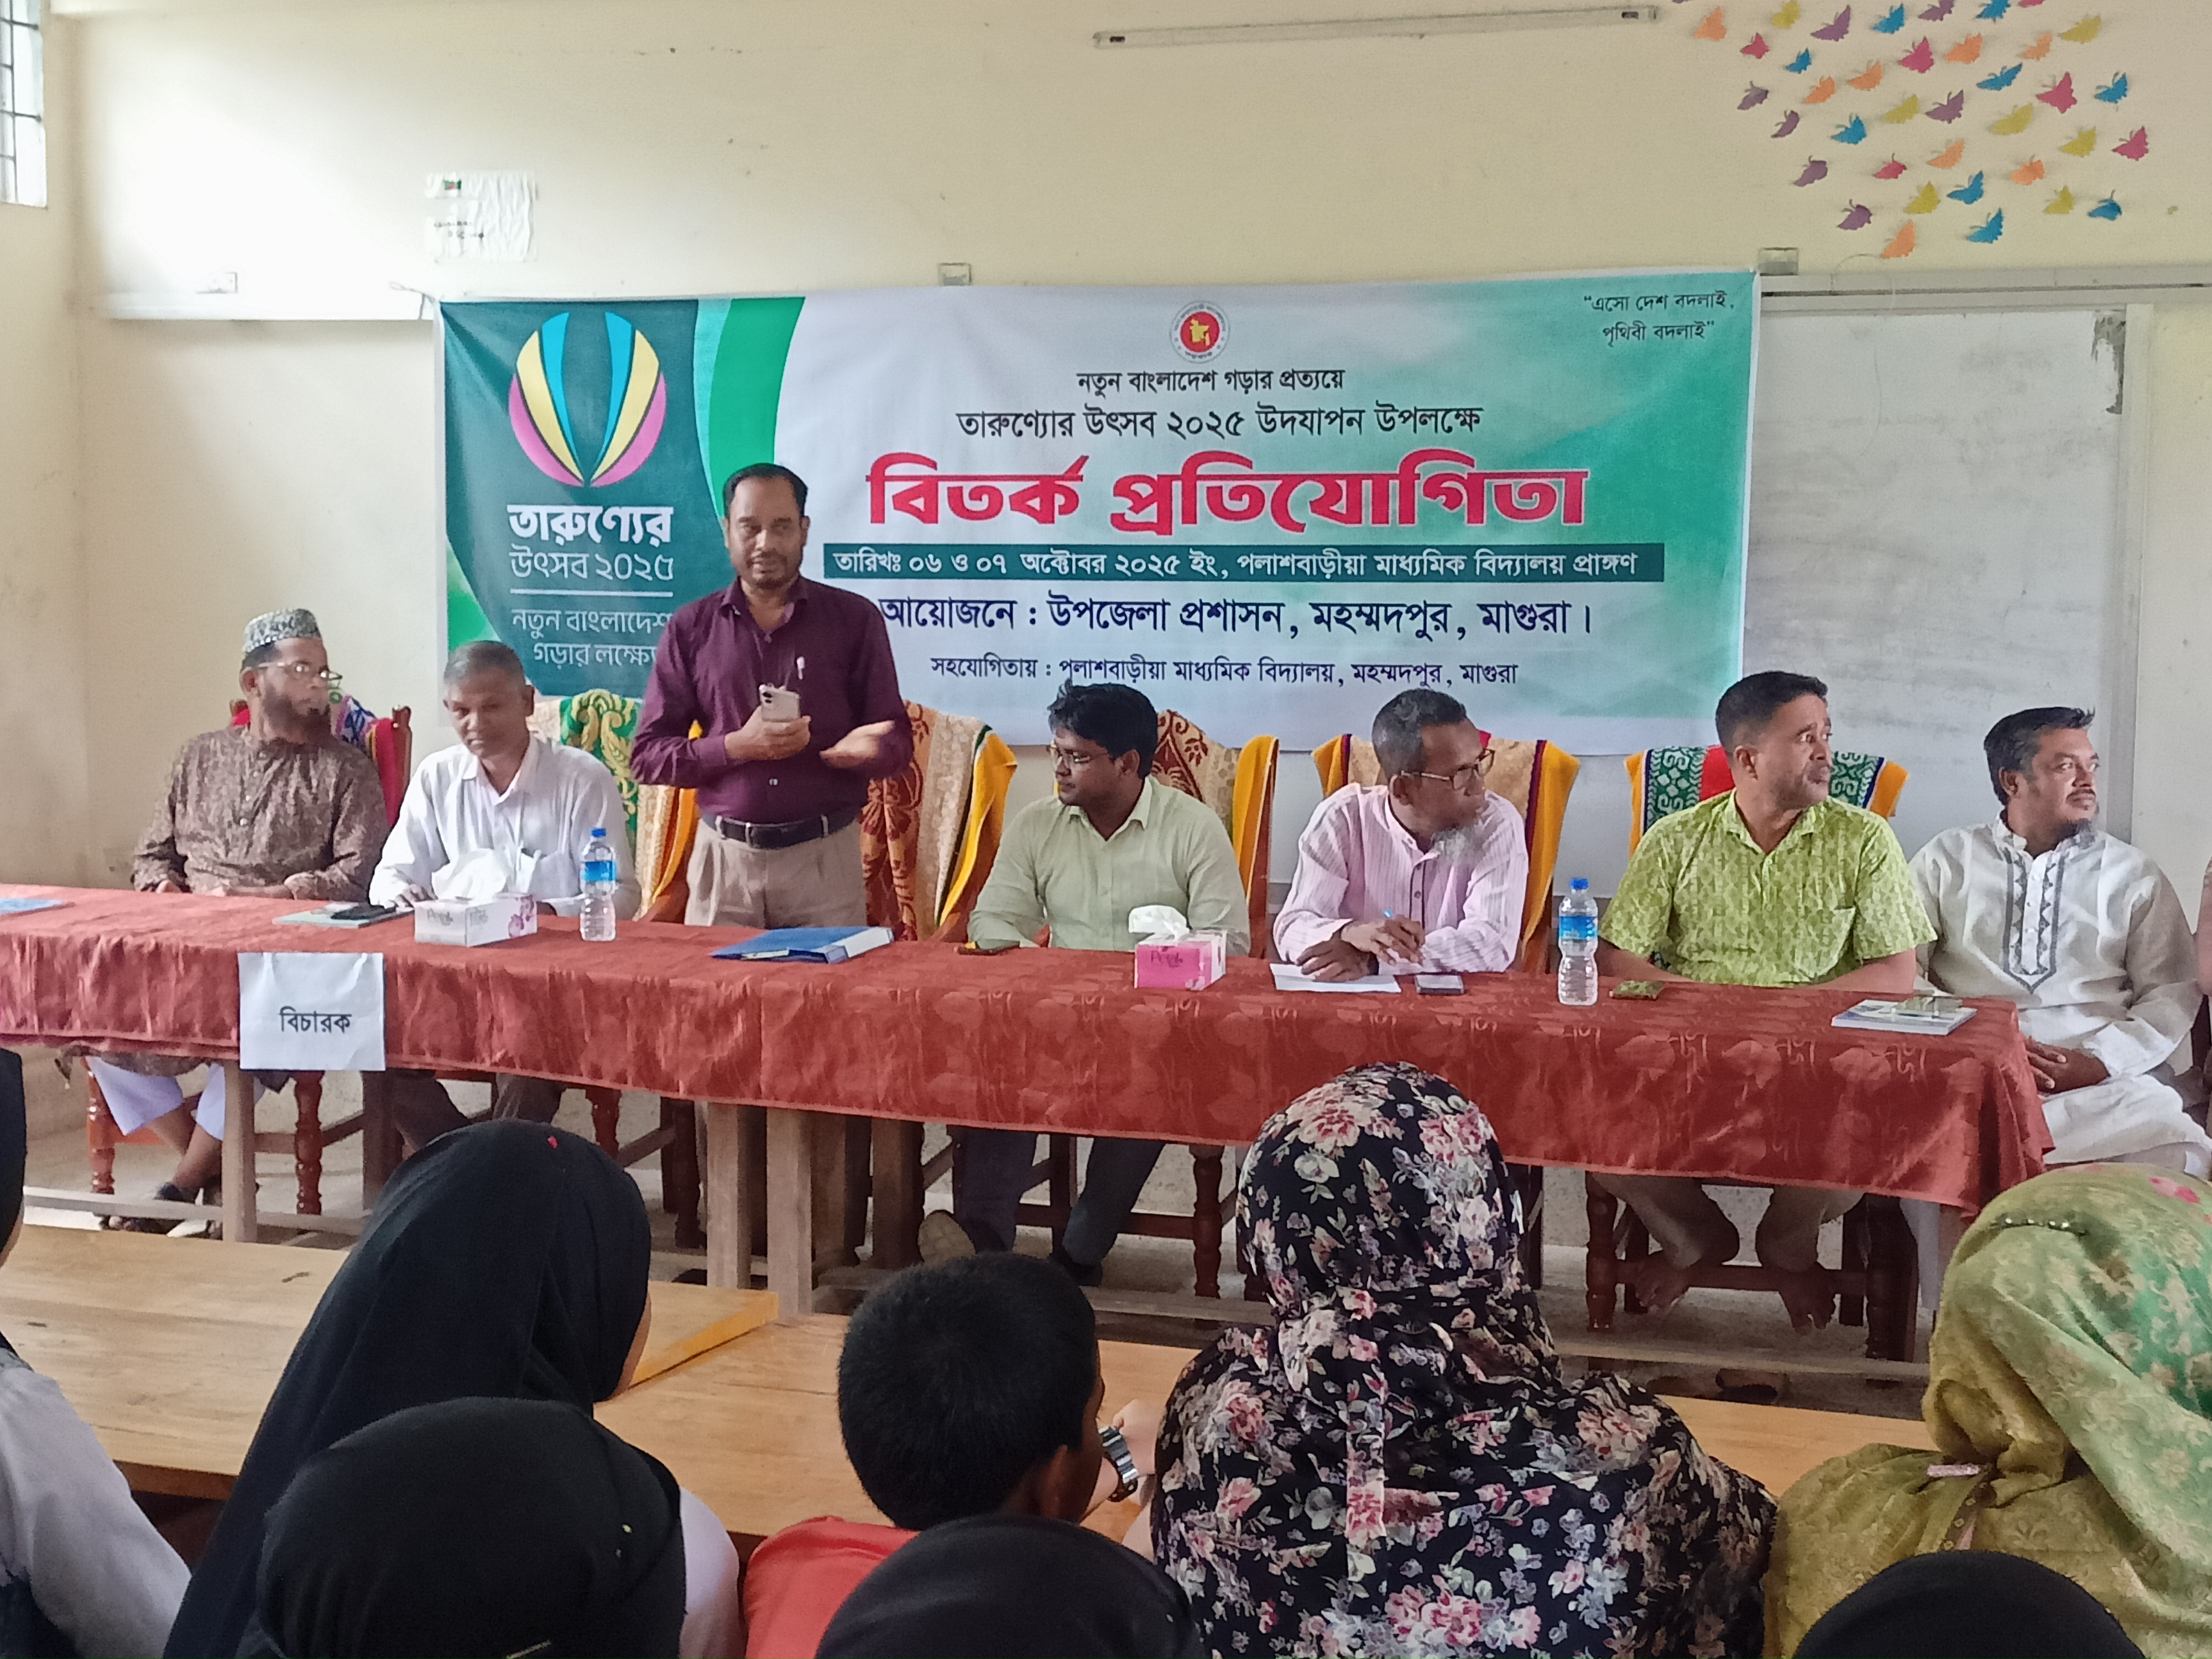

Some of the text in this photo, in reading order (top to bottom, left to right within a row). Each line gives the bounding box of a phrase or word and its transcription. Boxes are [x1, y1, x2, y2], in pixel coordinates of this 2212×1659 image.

[1636, 295, 1668, 311] দেশ
[1603, 320, 1646, 347] পৃথিবী
[1076, 368, 1345, 398] নতুন বাংলাদেশ গড়ার প্রত্যয়ে
[1082, 403, 1157, 437] উৎসব
[1167, 411, 1244, 440] ২০২৫
[1255, 401, 1365, 436] উদযাপন
[1374, 399, 1484, 435] উপলক্ষে
[865, 449, 1590, 535] বিতর্ক প্রতিযোগিতা
[507, 504, 674, 547] তারুণ্যের
[508, 544, 674, 581] উৎসব ২০২৫
[909, 554, 942, 573] ০৬
[951, 555, 969, 572] ও
[976, 554, 1007, 574] ০৭
[1020, 548, 1108, 575] অক্টোবর
[1115, 555, 1181, 577] ২০২৫
[1237, 548, 1368, 579] পলাশবাড়ীয়া
[1374, 549, 1468, 576] মাধ্যমিক
[1473, 548, 1567, 577] বিদ্যালয়
[1572, 552, 1639, 576] প্রাঙ্গণ
[511, 609, 562, 639] নতুন
[878, 596, 1018, 630] আয়োজনে
[1046, 589, 1171, 632] উপজেলা
[533, 643, 591, 669] গড়ার
[930, 651, 1039, 678] সহযোগিতায়
[1058, 653, 1167, 684] পলাশবাড়ীয়া
[1172, 655, 1252, 681] মাধ্যমিক
[1459, 663, 1519, 685] মাগুরা
[278, 1005, 352, 1033] বিচারক
